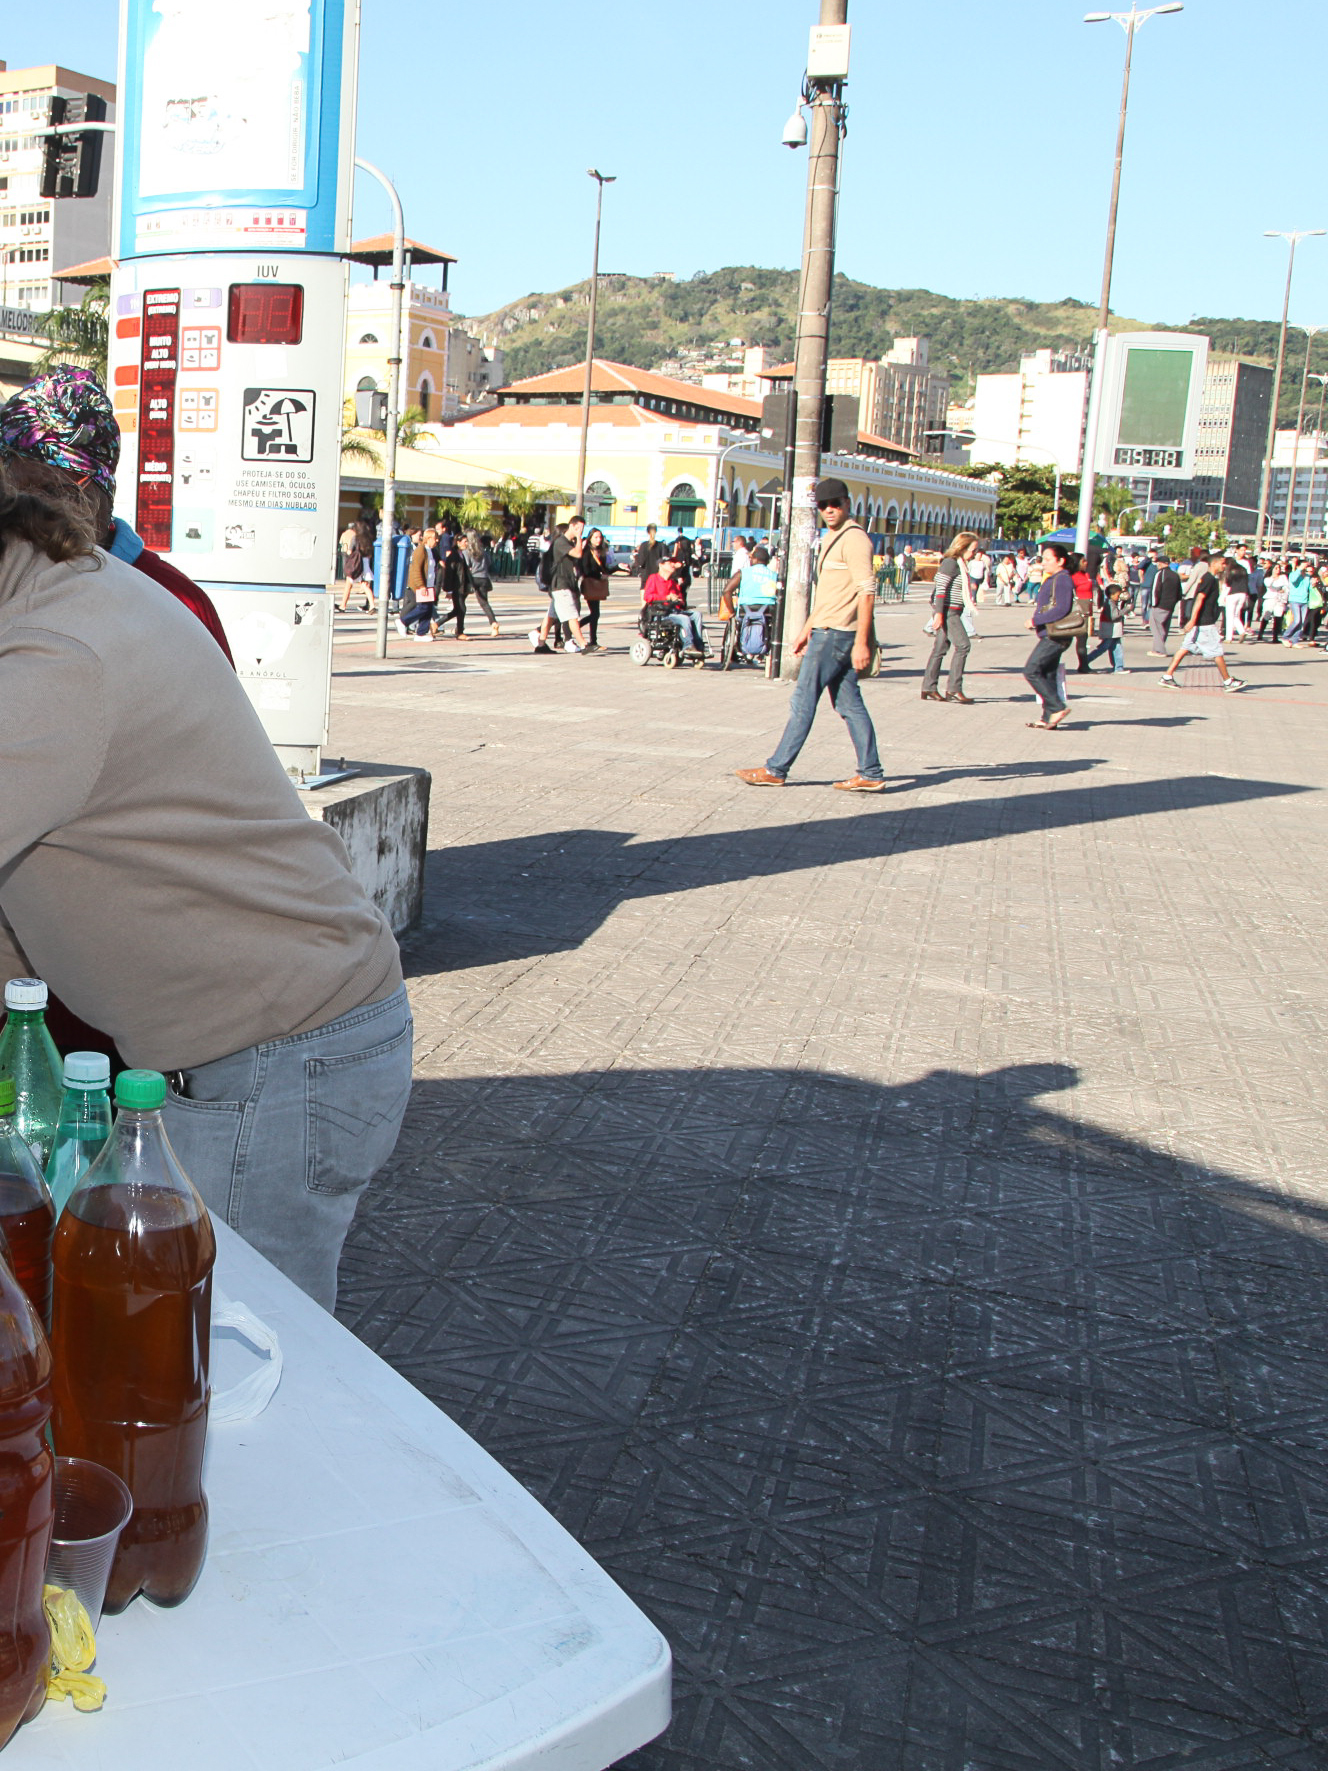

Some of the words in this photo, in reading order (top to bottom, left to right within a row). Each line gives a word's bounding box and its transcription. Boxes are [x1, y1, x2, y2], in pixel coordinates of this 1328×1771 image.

[257, 265, 279, 278] IUV
[146, 293, 179, 304] EXTREMO
[151, 348, 169, 359] ALTO
[149, 399, 168, 409] ALTO
[242, 470, 284, 479] PROTEJA-SE
[285, 471, 295, 479] DO
[250, 480, 287, 489] CAMISETA,
[288, 480, 316, 490] ÓCULOS
[233, 489, 261, 498] CHAPÉU
[262, 490, 267, 498] E
[268, 490, 291, 498] FILTRO
[228, 499, 254, 507] MESMO
[255, 499, 266, 508] EM
[267, 500, 284, 508] DIAS
